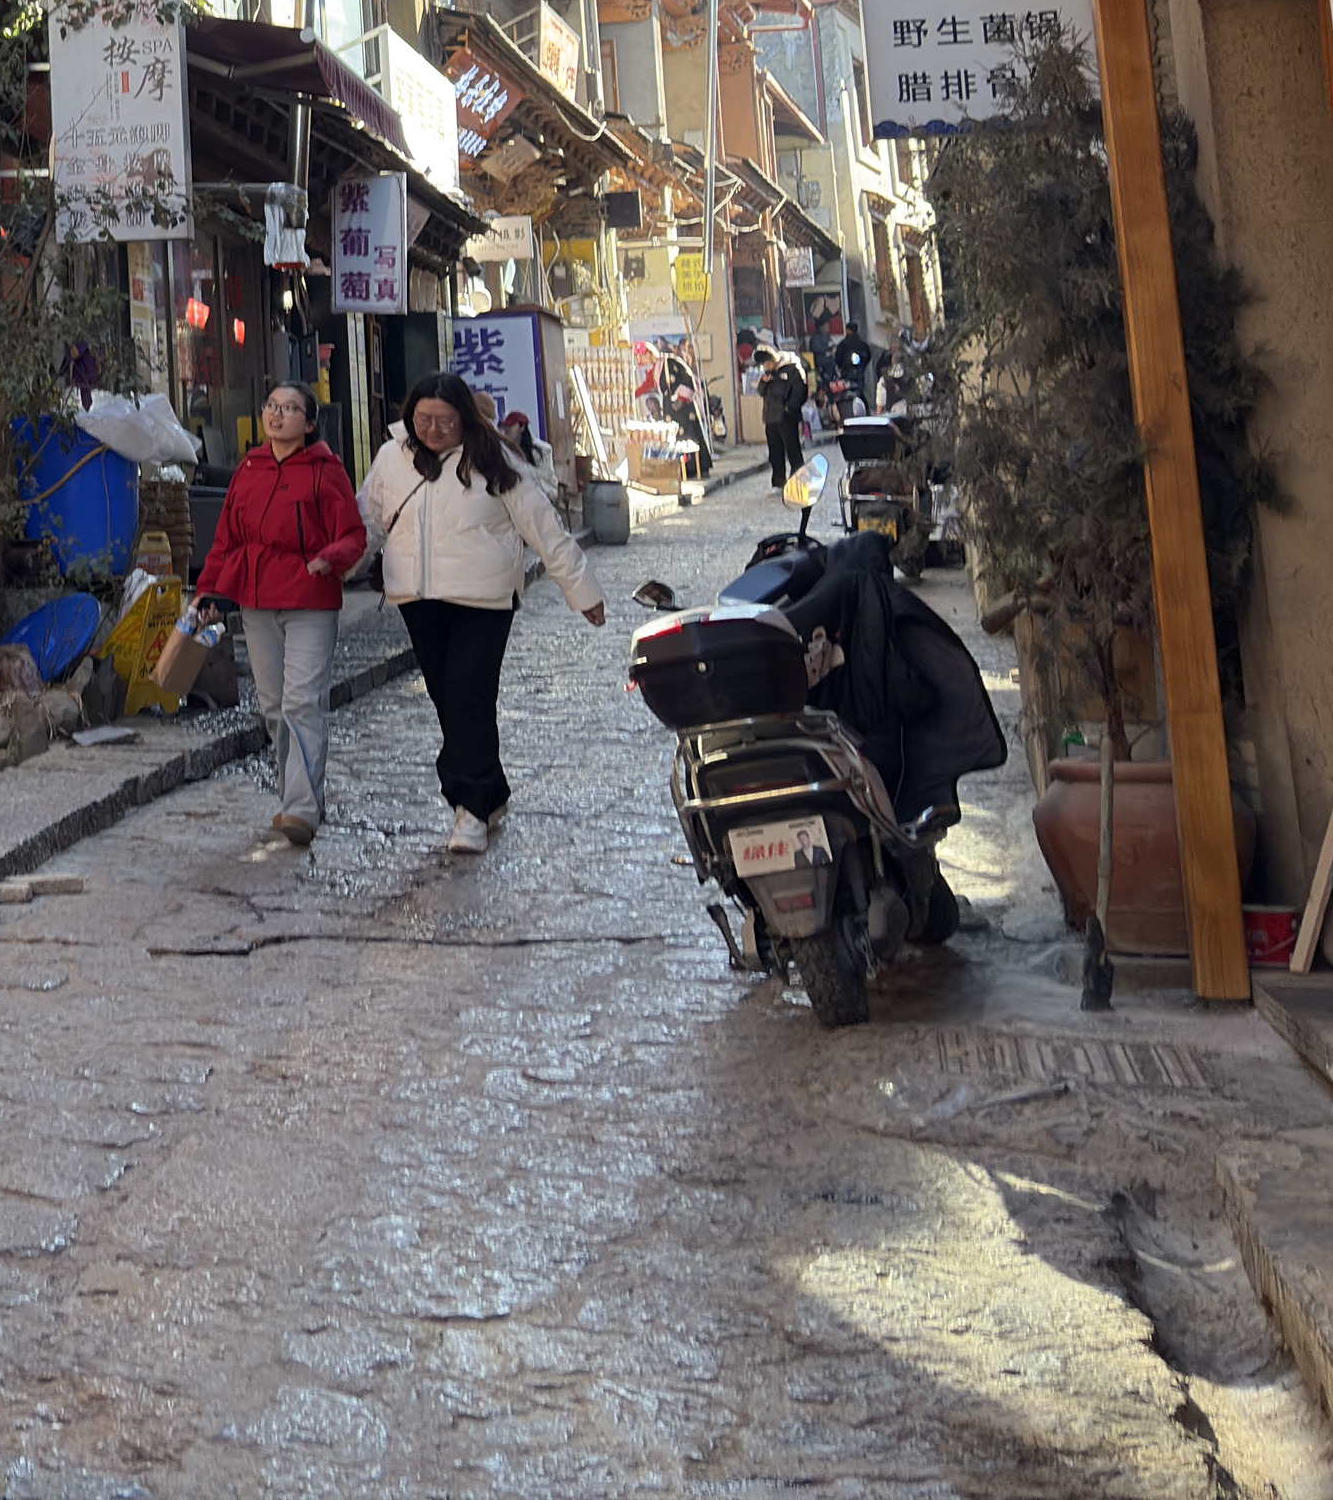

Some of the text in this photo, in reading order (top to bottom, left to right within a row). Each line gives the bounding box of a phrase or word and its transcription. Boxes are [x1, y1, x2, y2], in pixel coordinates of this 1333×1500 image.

[142, 38, 173, 55] SPA
[893, 10, 1061, 48] 野生菌锅
[898, 68, 1035, 104] 腊排骨
[63, 122, 171, 150] 十五元泡脚
[339, 181, 371, 301] 紫葡萄
[374, 245, 398, 301] 写真
